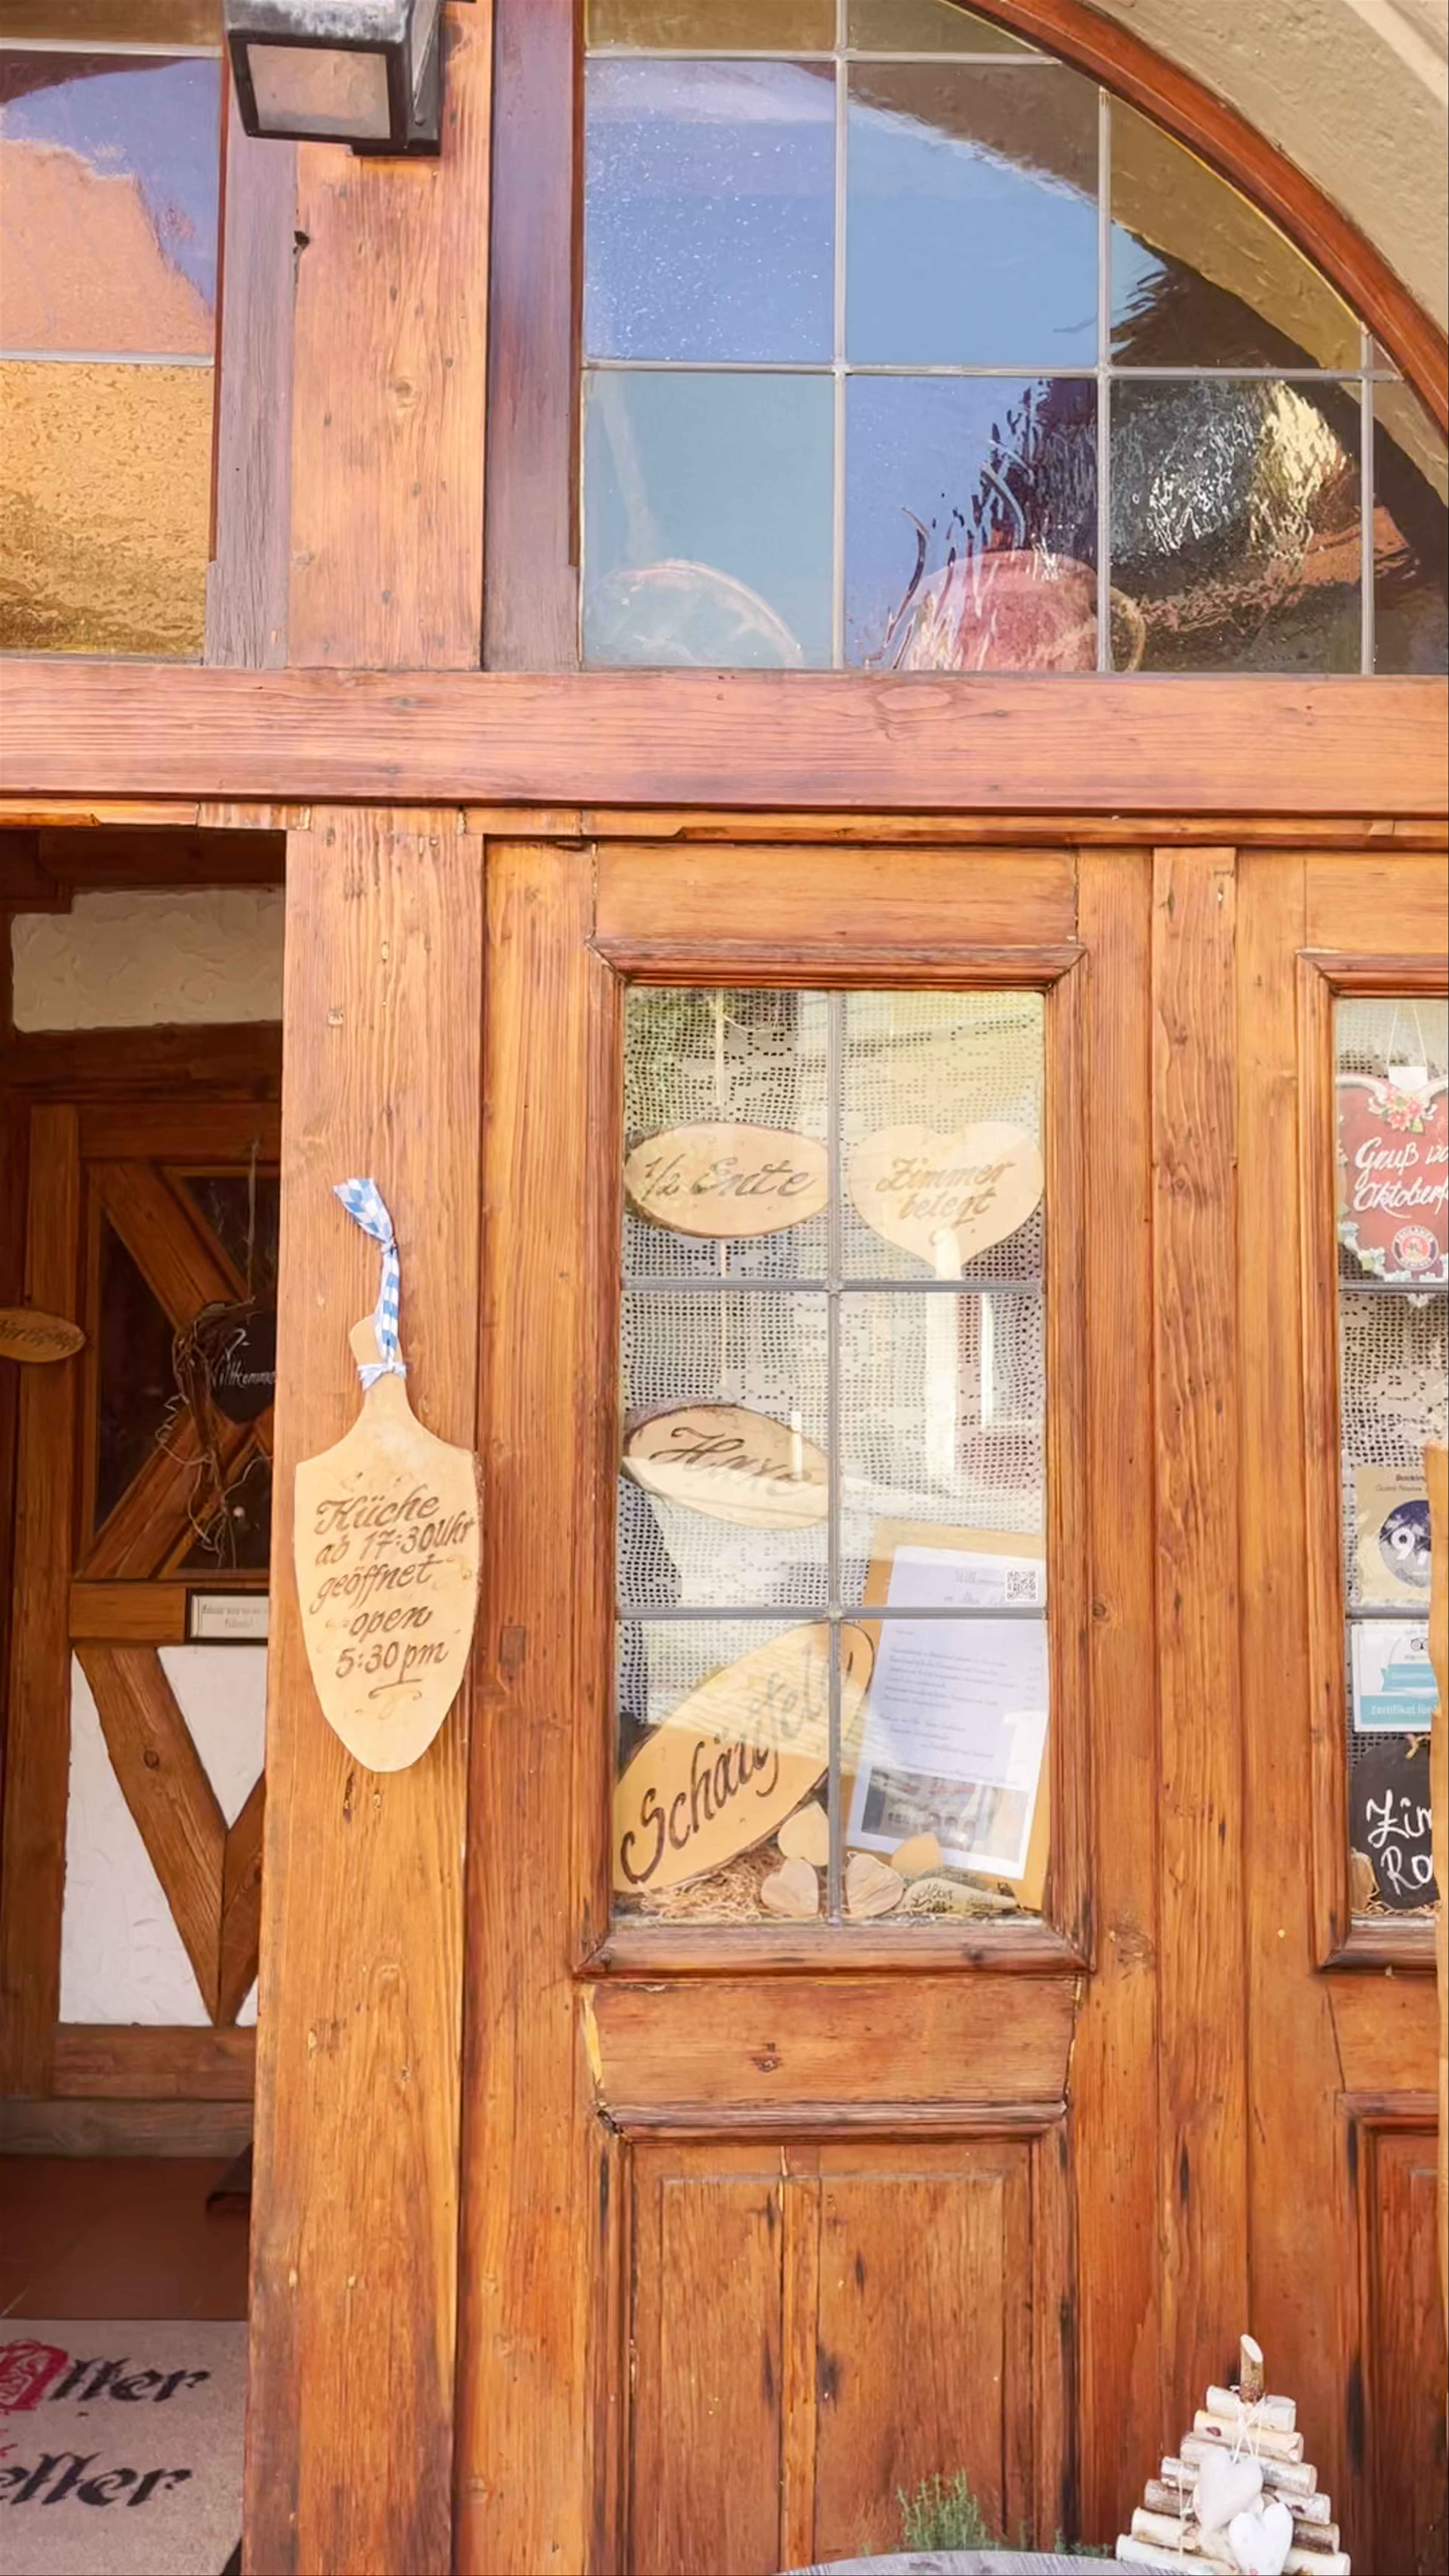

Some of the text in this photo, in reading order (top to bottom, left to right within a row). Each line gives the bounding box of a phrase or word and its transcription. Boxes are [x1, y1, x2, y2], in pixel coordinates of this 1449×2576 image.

[690, 1156, 818, 1198] Ente
[875, 1158, 1016, 1194] Zimmer
[1354, 1137, 1420, 1189] Gruß
[898, 1188, 998, 1229] belegt
[314, 1483, 440, 1535] Küche
[316, 1535, 351, 1567] ab
[310, 1553, 443, 1615] geöffnet
[349, 1606, 433, 1643] open
[1380, 1845, 1432, 1896] Ro
